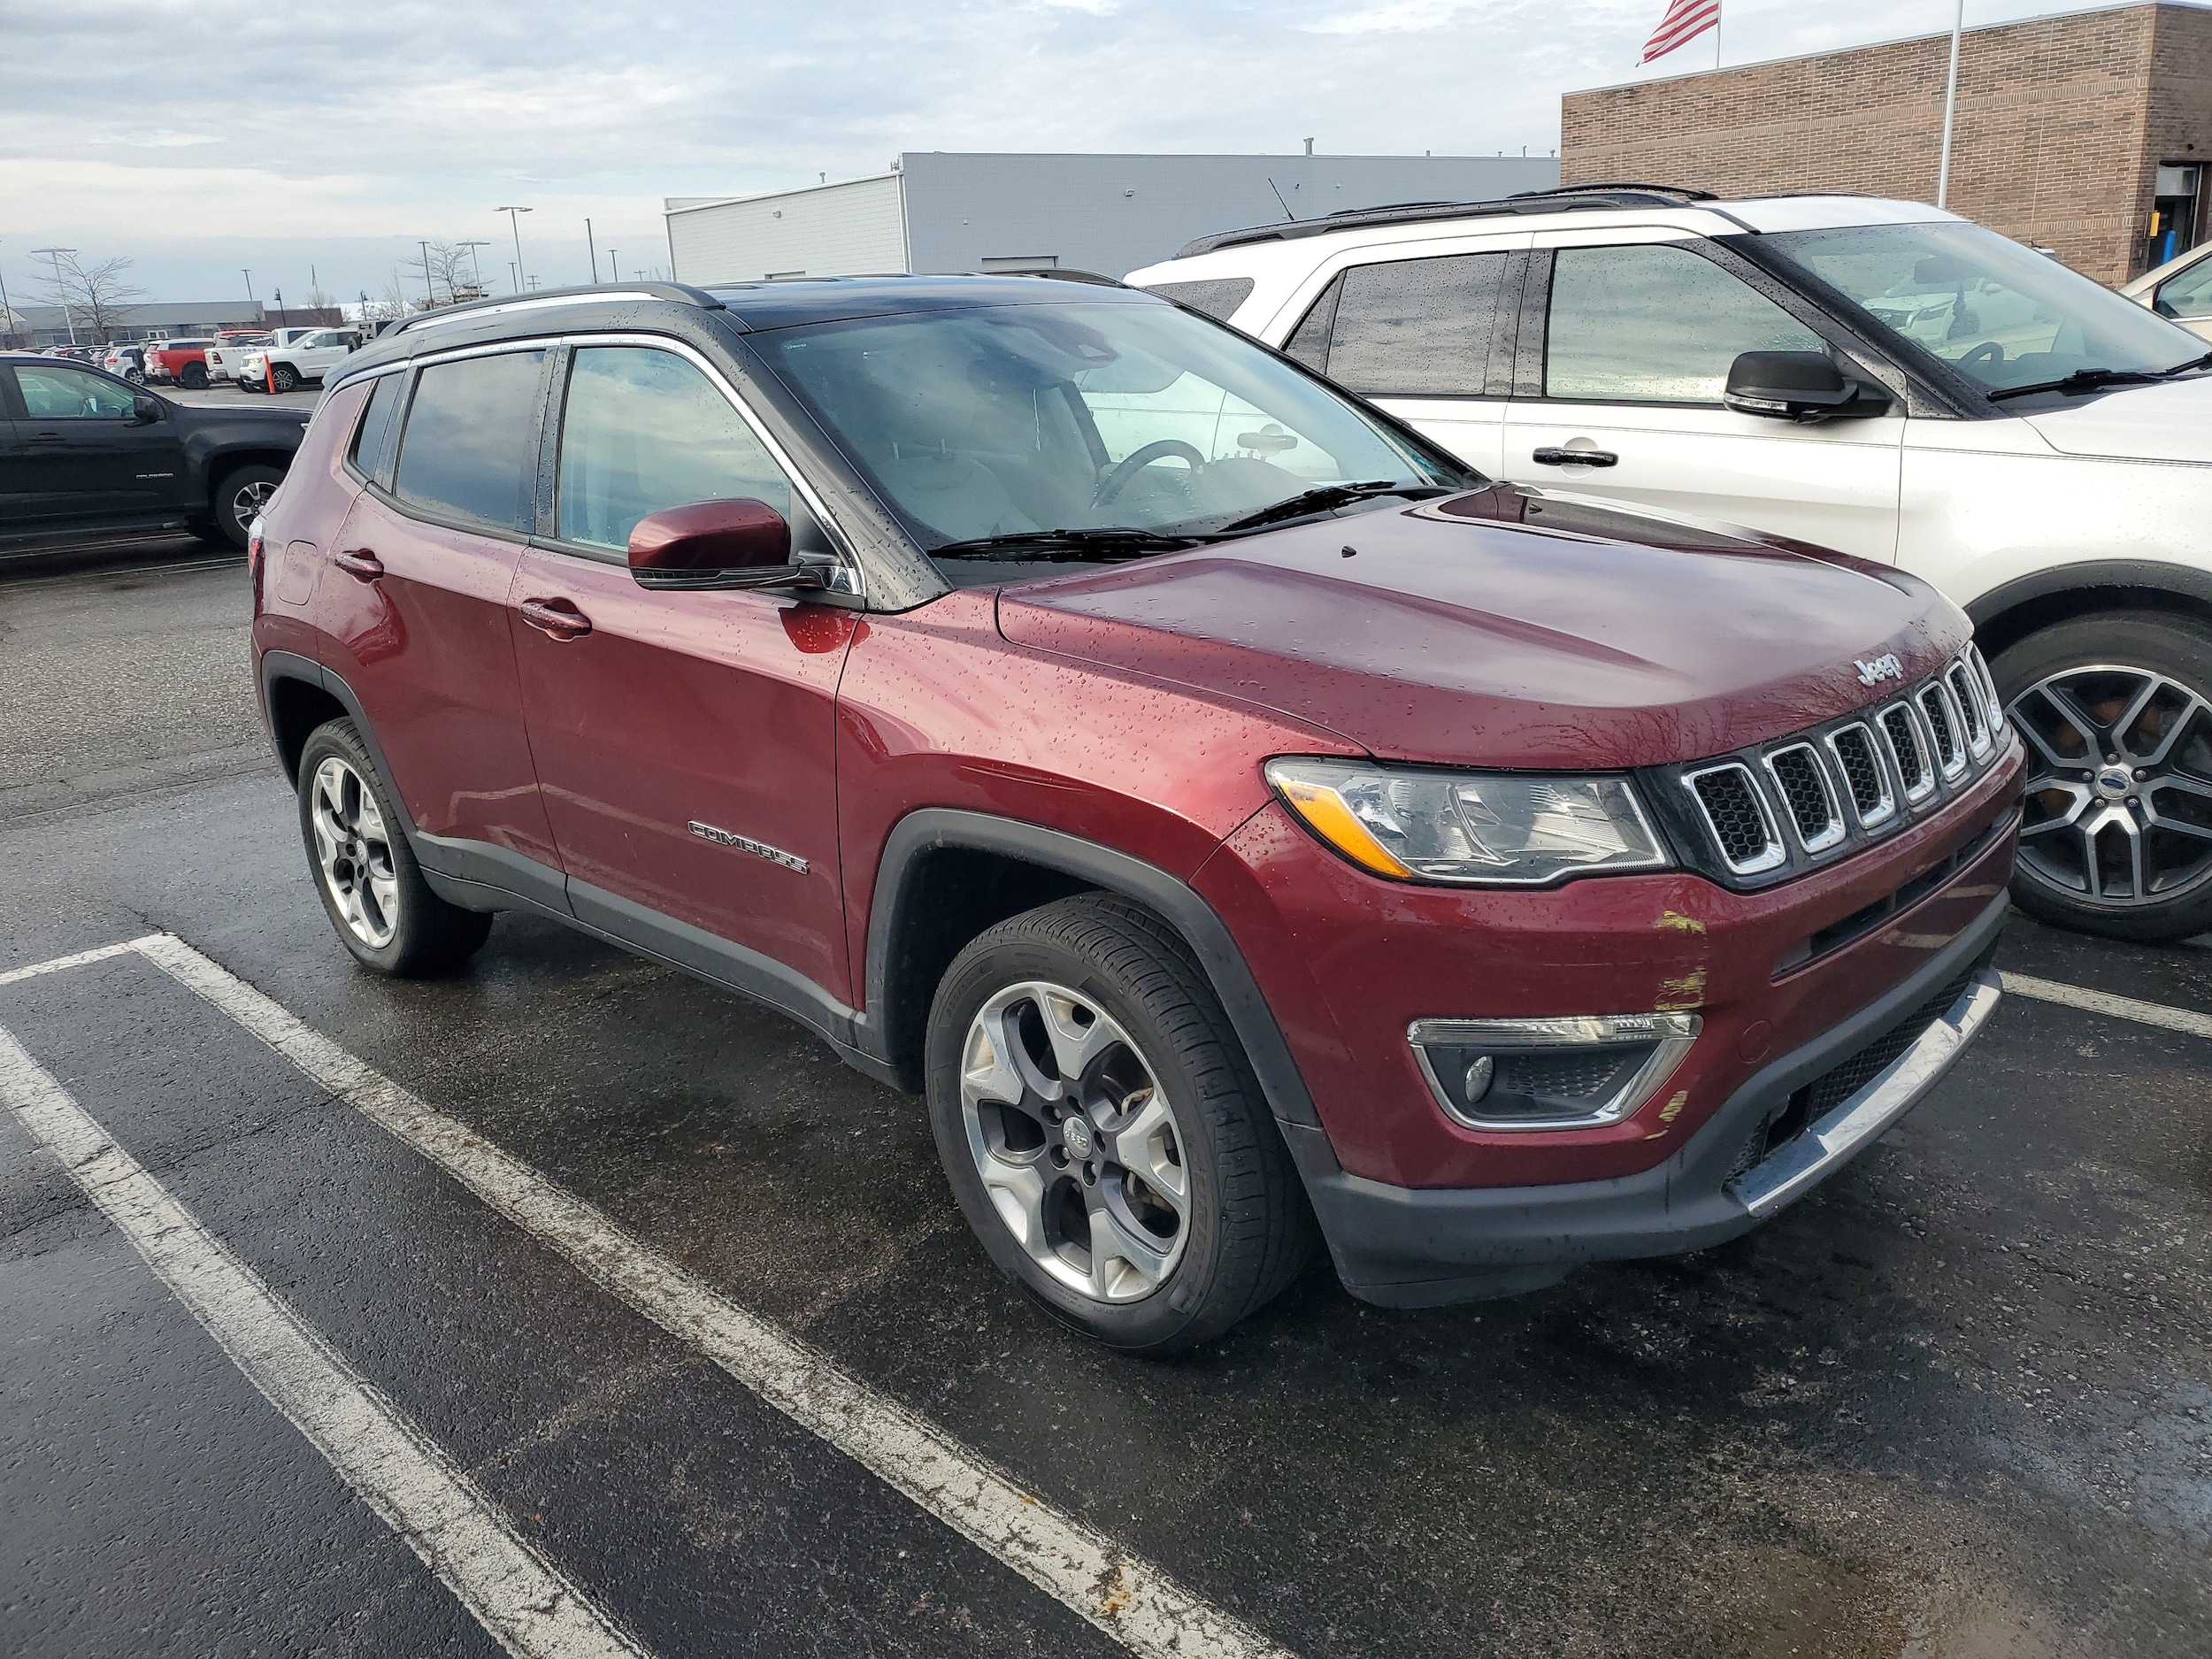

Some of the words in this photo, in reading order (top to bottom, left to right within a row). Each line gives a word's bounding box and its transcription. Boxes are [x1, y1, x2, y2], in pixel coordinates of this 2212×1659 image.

[1853, 653, 1903, 687] Jeep
[687, 820, 810, 875] COMPASS
[1064, 1127, 1088, 1148] Jeep
